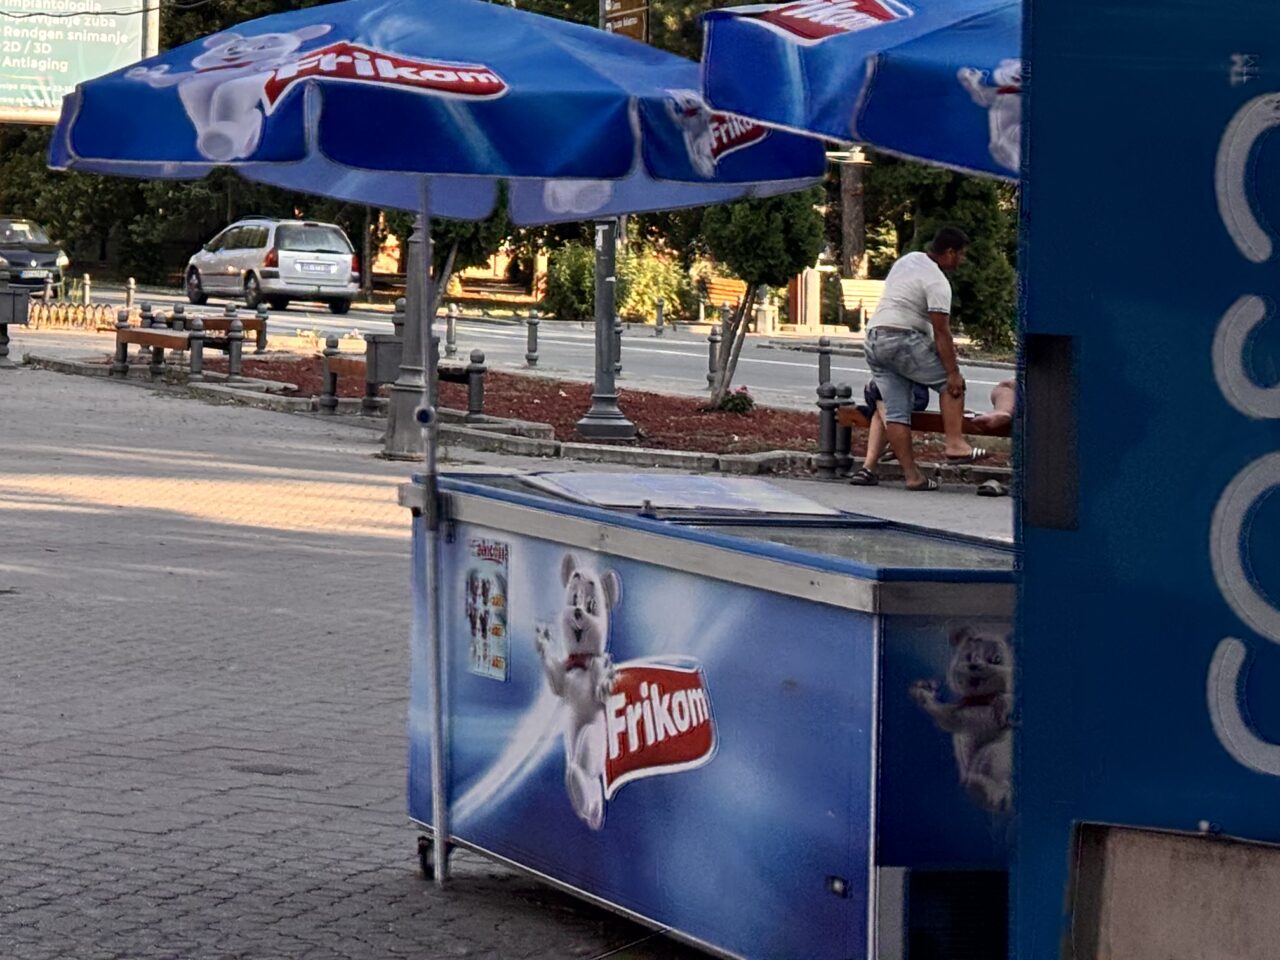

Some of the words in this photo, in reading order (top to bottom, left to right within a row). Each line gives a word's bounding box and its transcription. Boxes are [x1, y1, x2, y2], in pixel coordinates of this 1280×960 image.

[84, 16, 116, 27] zuba
[3, 26, 64, 41] Rendgen
[67, 30, 128, 45] snimanje
[2, 41, 21, 52] 2D
[33, 42, 52, 54] 3D
[2, 56, 69, 72] Antiaging
[275, 51, 500, 84] Frikom
[709, 116, 754, 149] Friko
[605, 681, 709, 760] Frikom
